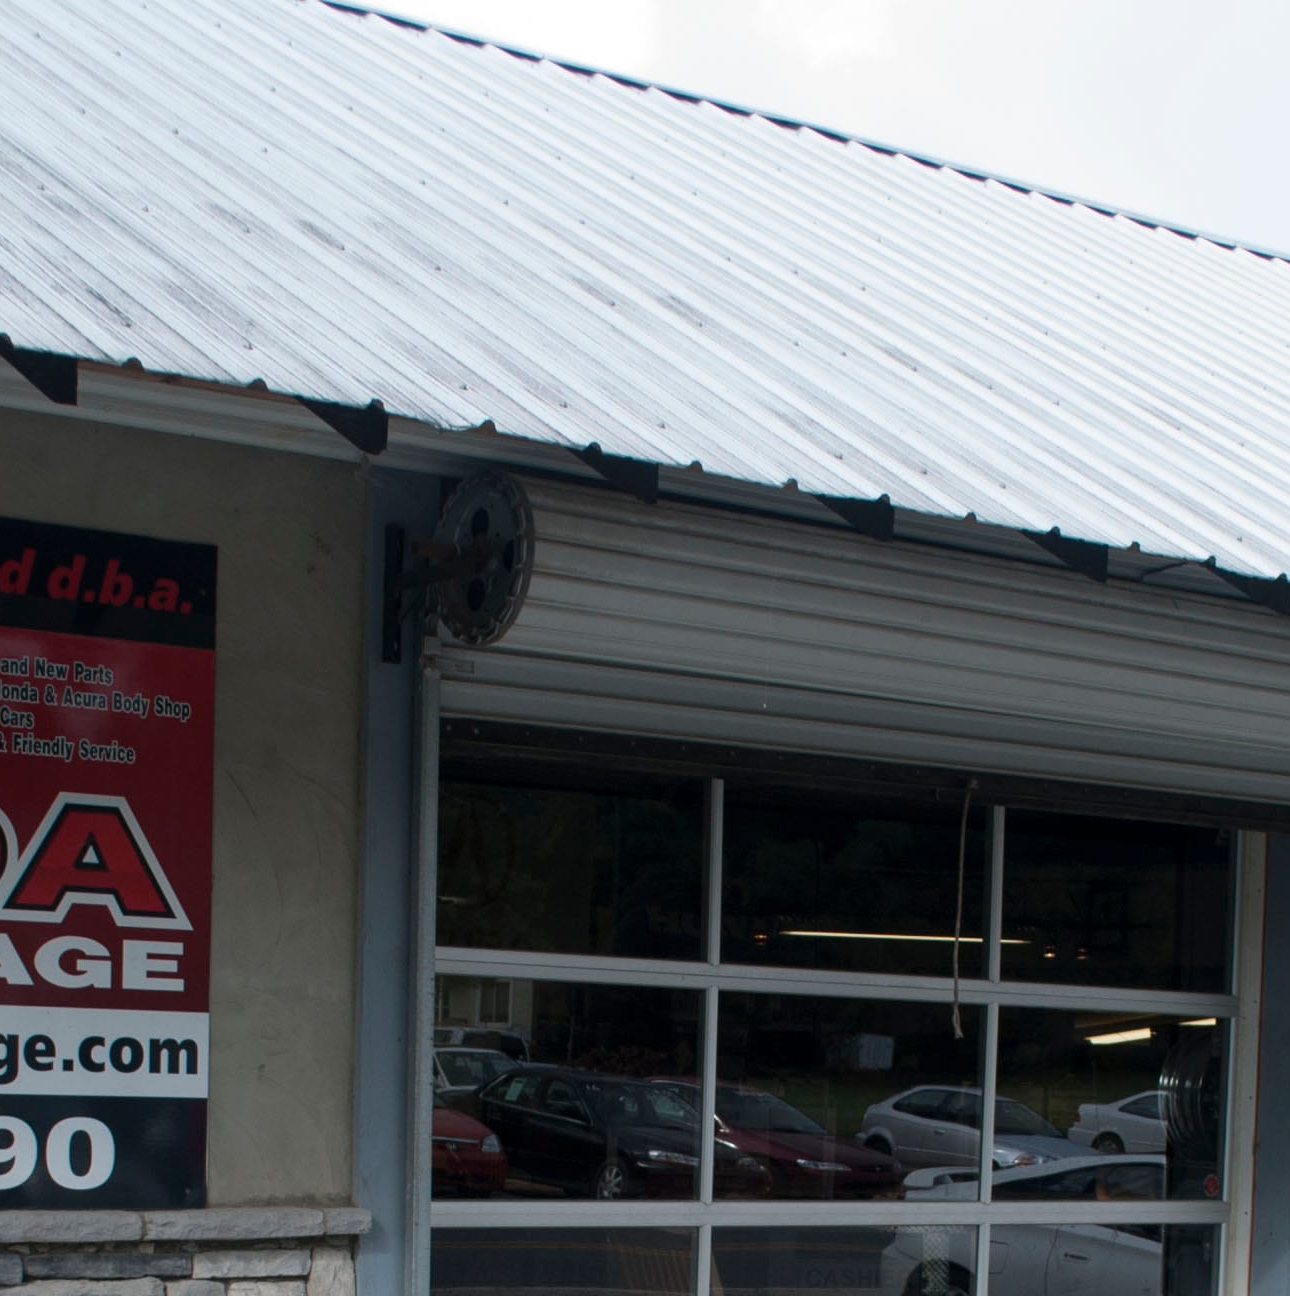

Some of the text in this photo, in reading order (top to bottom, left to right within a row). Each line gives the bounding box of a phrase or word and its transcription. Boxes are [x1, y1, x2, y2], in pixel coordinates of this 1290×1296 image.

[47, 555, 193, 614] d.b.a.
[0, 656, 29, 675] and
[34, 658, 68, 680] New
[74, 662, 113, 685] Parts
[0, 705, 34, 729] Cars
[44, 685, 57, 705] &
[62, 687, 108, 710] Acura
[112, 692, 150, 718] Body
[154, 695, 191, 722] Shop
[12, 733, 74, 762] Friendly
[79, 740, 136, 764] Service
